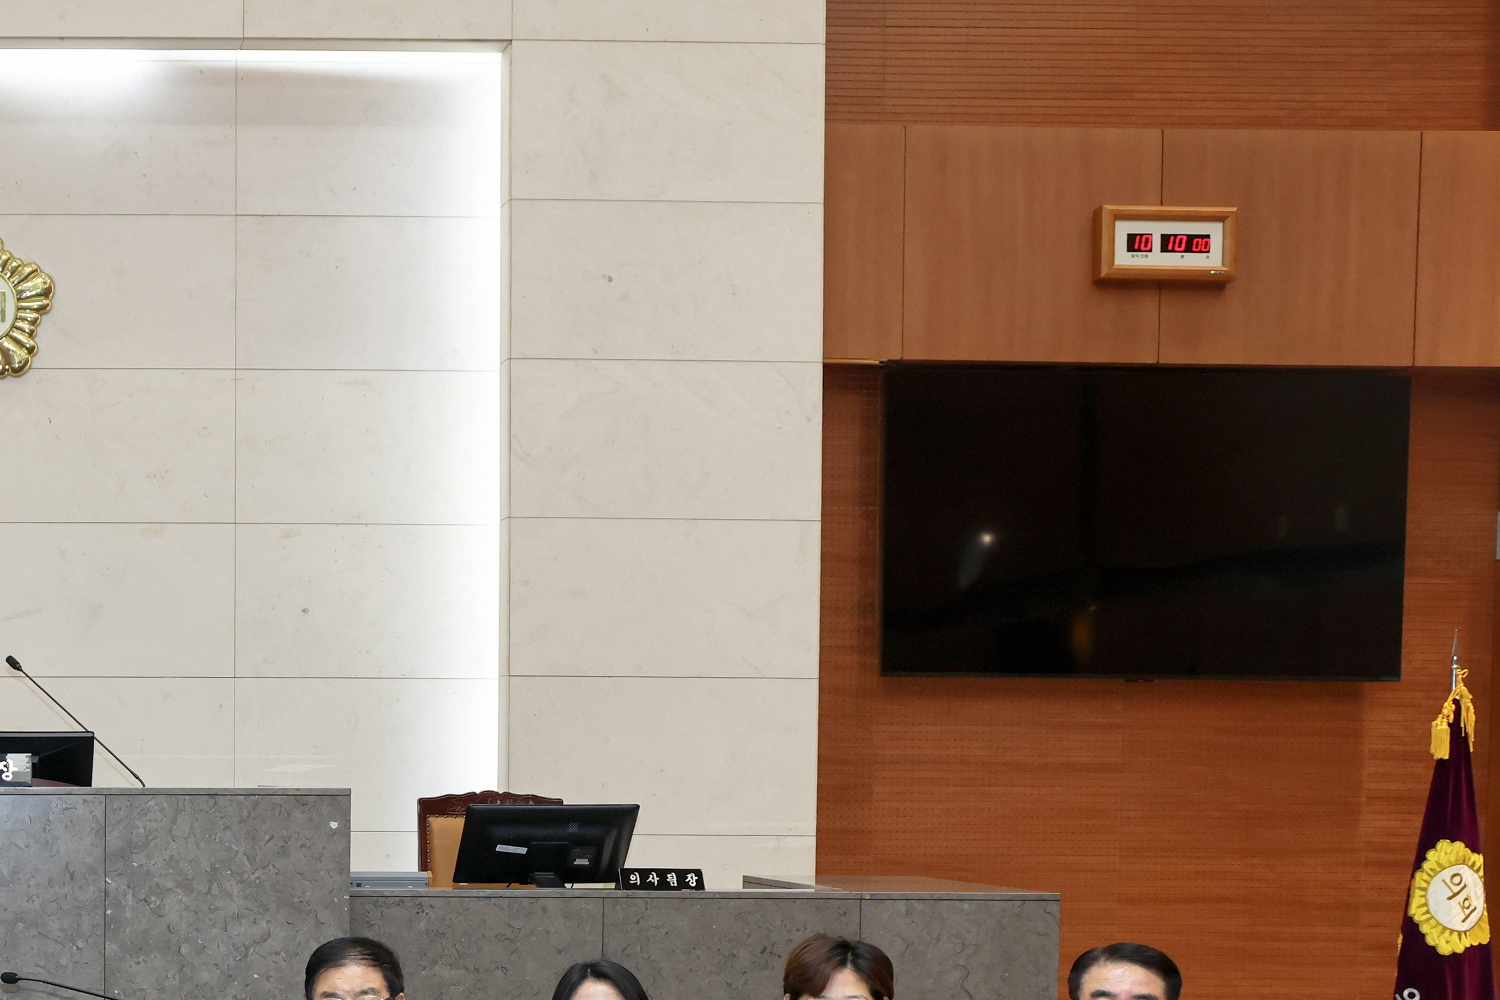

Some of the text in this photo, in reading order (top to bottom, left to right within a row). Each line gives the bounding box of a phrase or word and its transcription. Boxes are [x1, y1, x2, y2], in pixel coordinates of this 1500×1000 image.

[1134, 234, 1153, 251] 10
[1167, 235, 1211, 252] 10 00
[628, 871, 699, 887] 의사팀장
[1441, 872, 1477, 923] 의회
